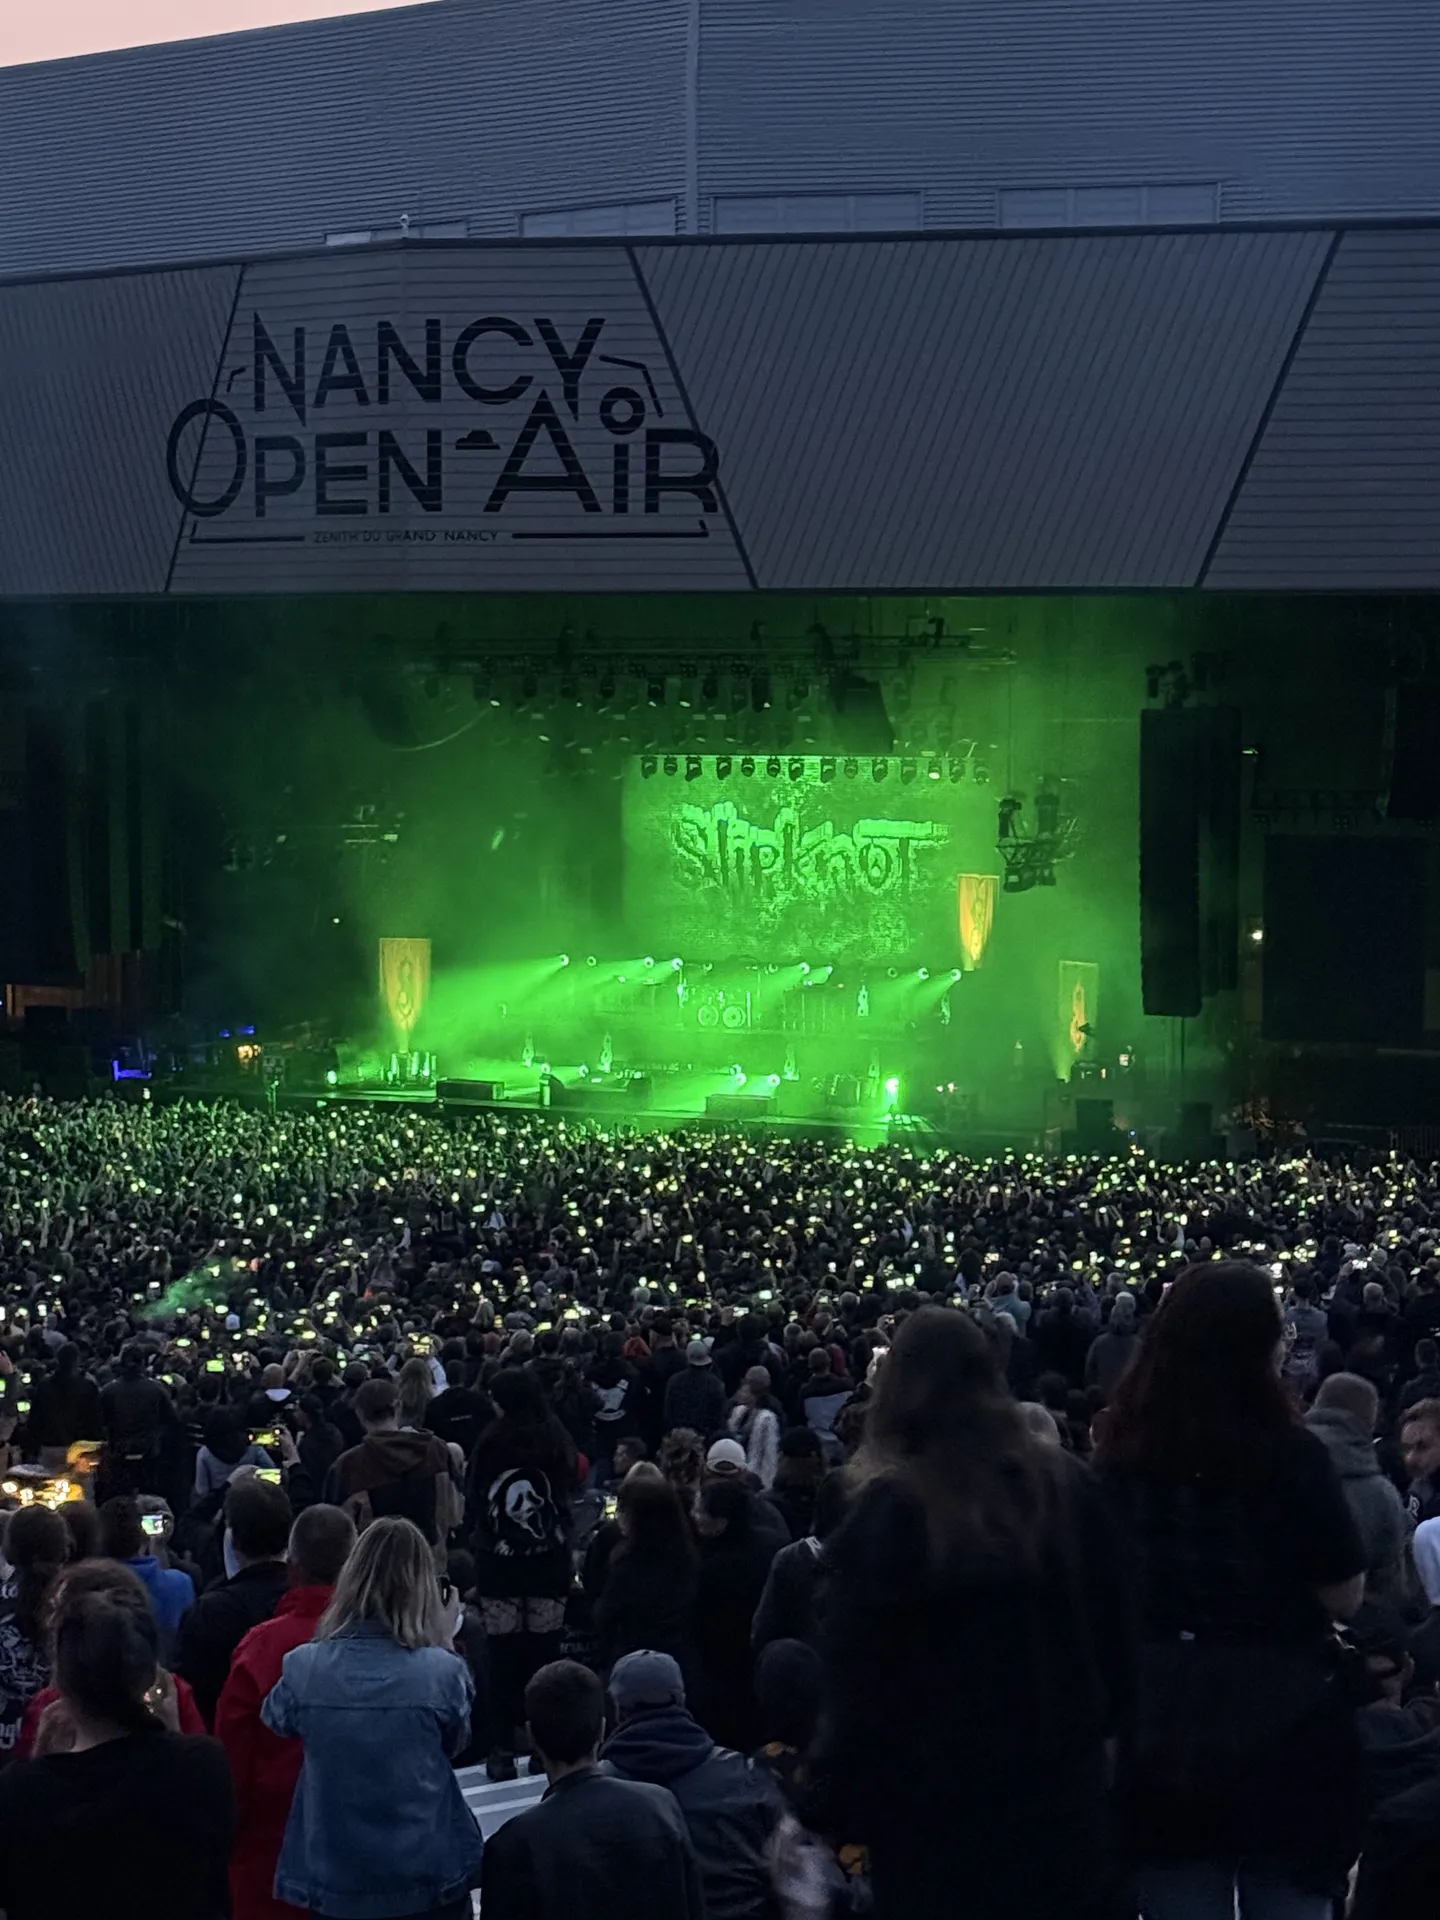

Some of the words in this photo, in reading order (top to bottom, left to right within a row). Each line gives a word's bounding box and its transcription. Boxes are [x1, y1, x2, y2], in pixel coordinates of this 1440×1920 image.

[253, 311, 605, 426] NANCY
[166, 398, 442, 517] OPEN
[363, 531, 380, 542] DU
[386, 530, 436, 542] GRAND
[444, 530, 498, 542] NANCY
